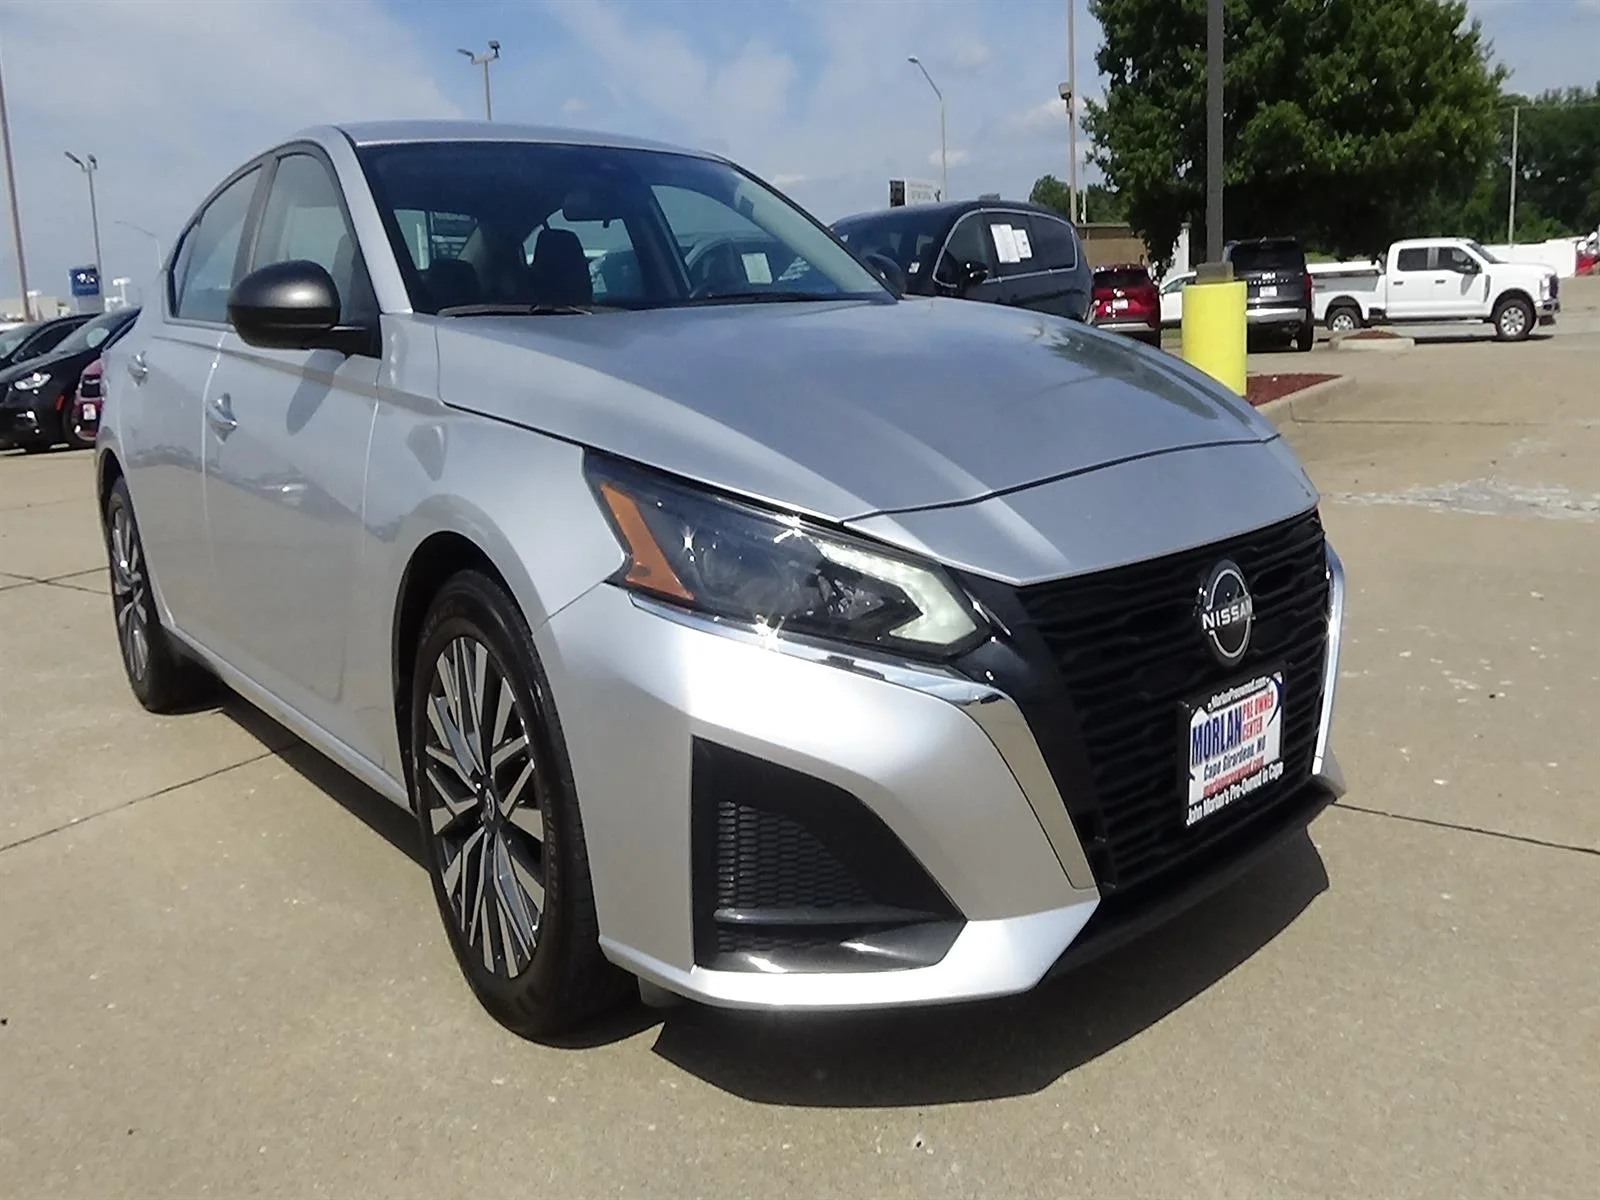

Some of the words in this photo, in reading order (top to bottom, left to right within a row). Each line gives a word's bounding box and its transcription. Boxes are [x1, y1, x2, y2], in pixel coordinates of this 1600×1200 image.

[1202, 599, 1253, 630] NISSAN
[1192, 706, 1242, 767] MORLAN
[1243, 716, 1263, 742] CENTER
[1204, 760, 1221, 781] Cape
[1186, 804, 1202, 826] John
[1203, 788, 1229, 816] Morlan's
[1230, 769, 1262, 801] Pre-Owned
[1262, 767, 1268, 784] in
[1269, 761, 1284, 781] Cape
